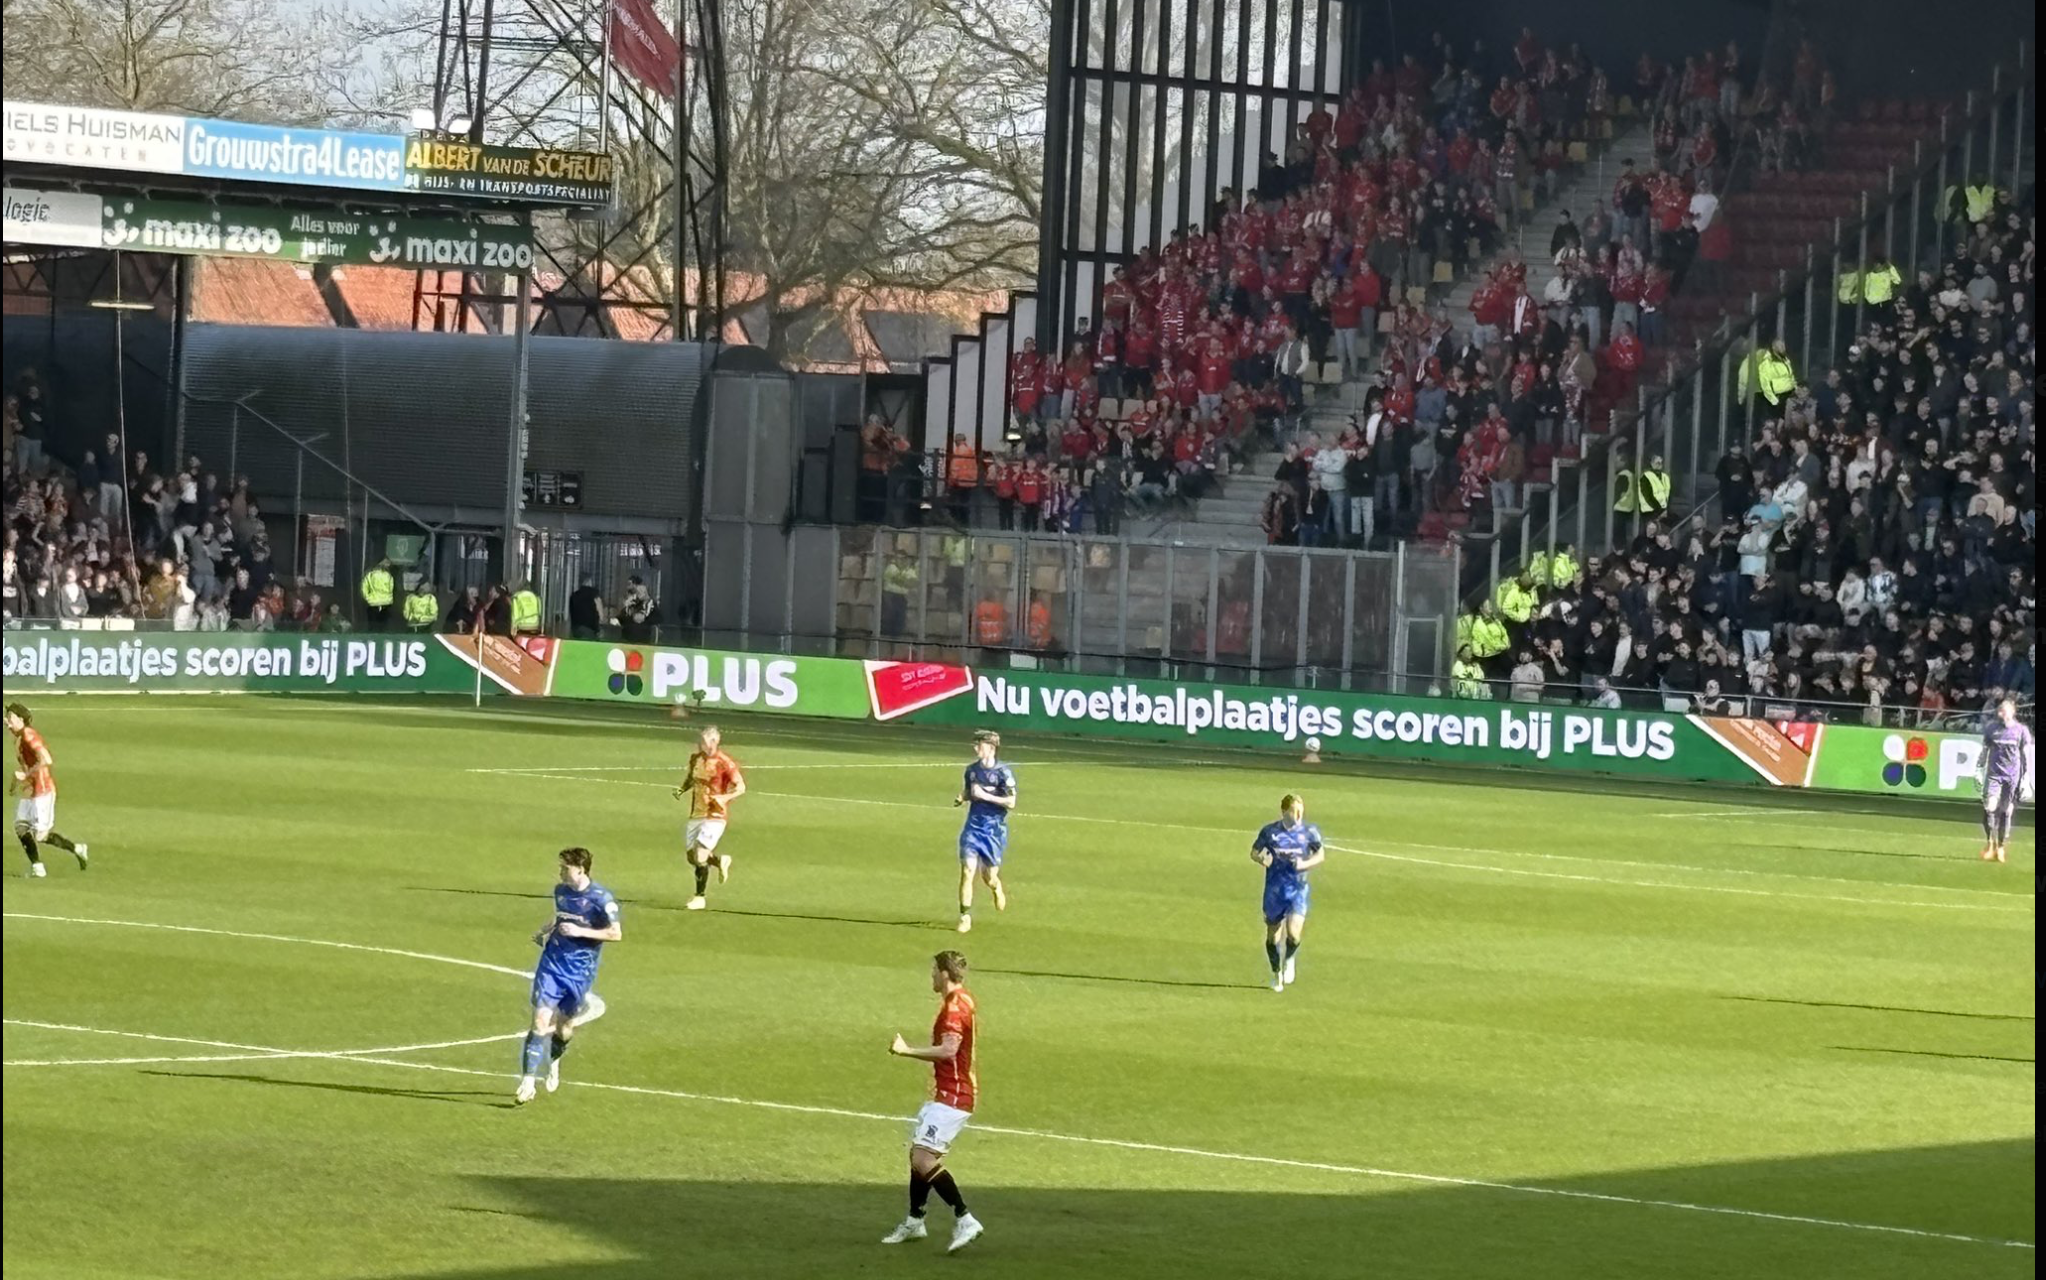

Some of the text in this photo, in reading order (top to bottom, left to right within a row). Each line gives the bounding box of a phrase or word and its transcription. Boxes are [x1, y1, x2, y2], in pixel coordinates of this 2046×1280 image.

[3, 111, 59, 134] IELS
[188, 123, 400, 181] Grouwstra4Lease
[405, 141, 482, 172] ALBERT
[142, 211, 282, 254] maxi zoo
[291, 214, 325, 233] Alles
[406, 228, 533, 269] maxi zoo
[184, 643, 291, 677] scoren
[300, 640, 338, 684] bij
[346, 641, 427, 678] PLUS
[653, 652, 798, 707] PLUS
[977, 675, 1030, 716] Nu
[1040, 684, 1343, 742] voetbalplaatjes
[1352, 708, 1489, 748] scoren
[1500, 709, 1552, 759] bij
[1564, 714, 1675, 760] PLUS
